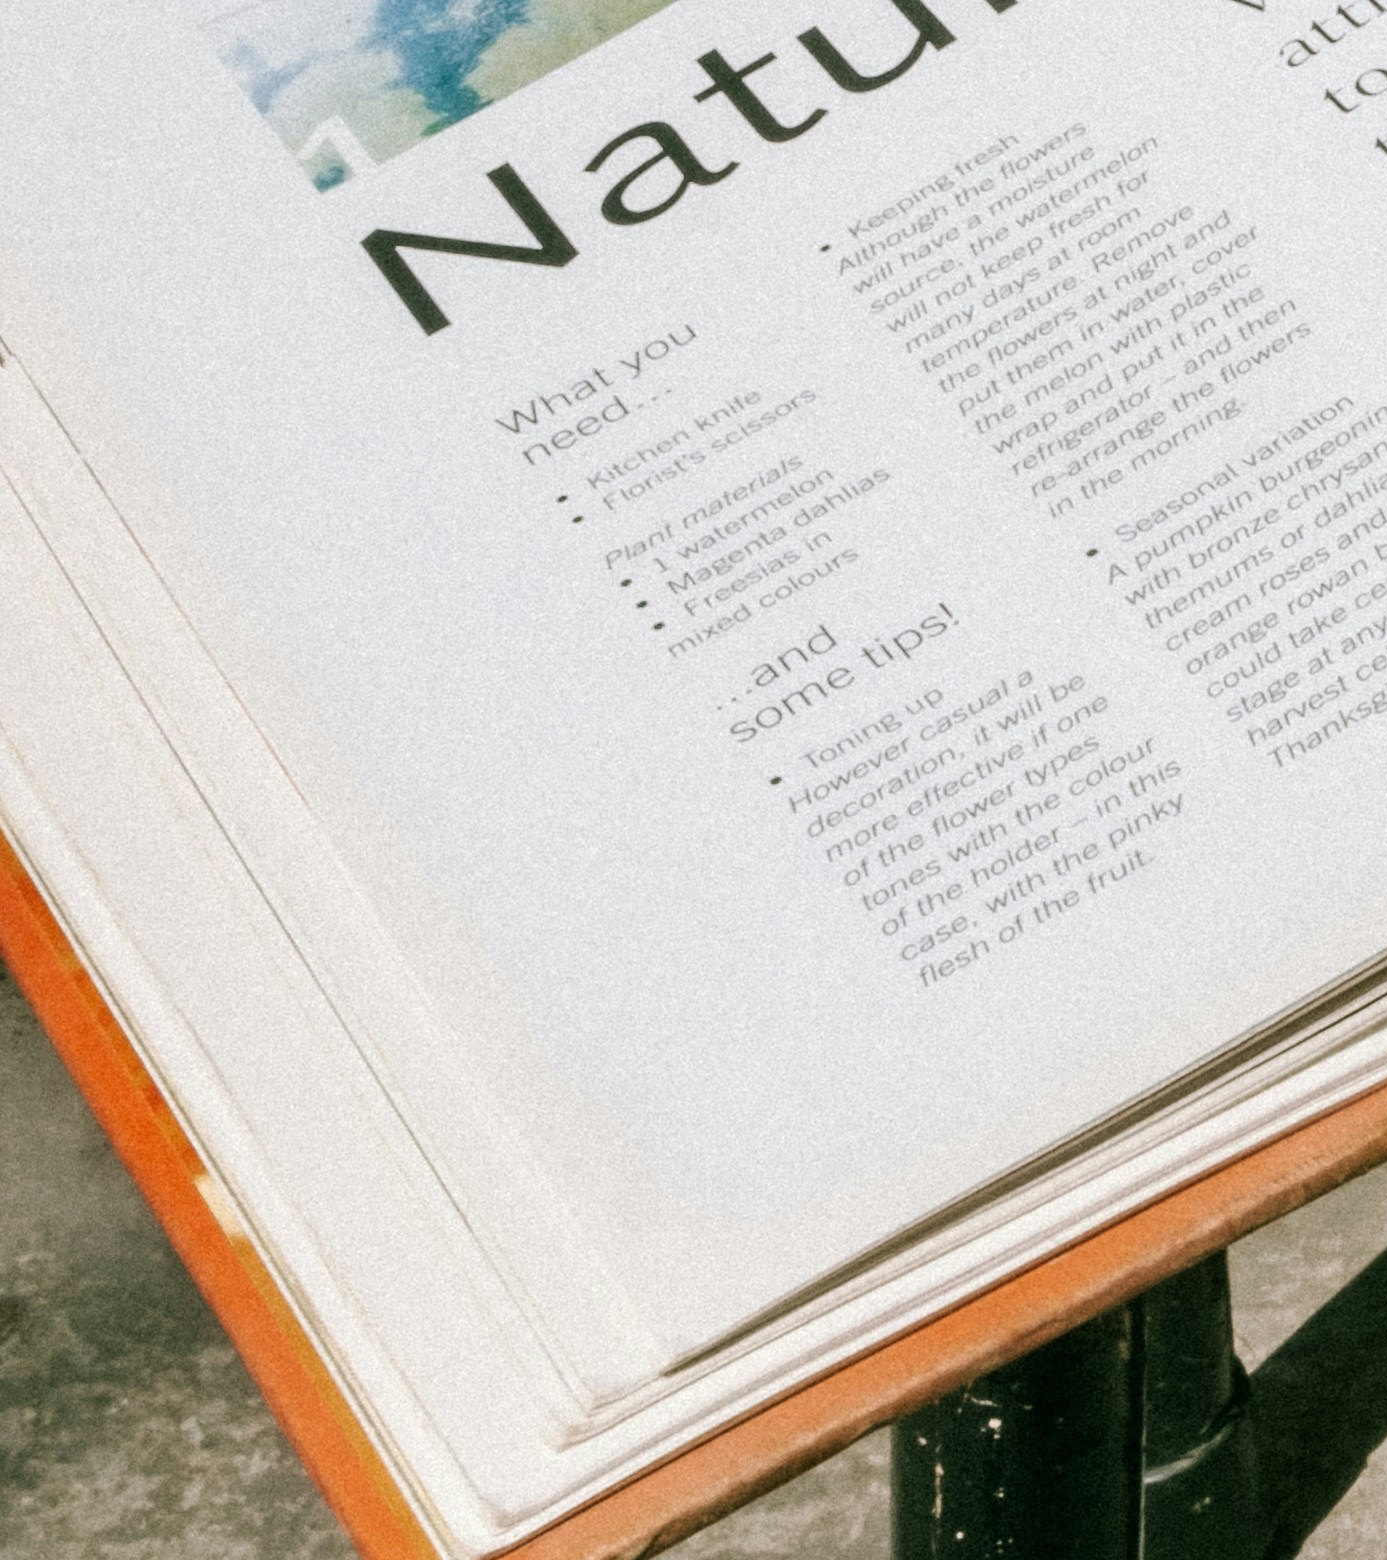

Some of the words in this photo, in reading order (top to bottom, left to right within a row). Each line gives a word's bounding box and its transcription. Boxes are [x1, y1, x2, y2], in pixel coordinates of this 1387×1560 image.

[837, 204, 949, 276] Although
[952, 177, 994, 208] the
[998, 121, 1087, 179] flowers
[845, 173, 955, 239] Keeping
[952, 133, 1020, 177] fresh
[851, 260, 894, 295] will
[898, 226, 959, 267] have
[966, 213, 982, 230] a
[987, 145, 1094, 216] moisture
[869, 258, 955, 314] source,
[967, 225, 1009, 257] the
[1014, 135, 1159, 229] watermelon
[493, 367, 612, 435] What
[618, 322, 698, 379] you
[585, 428, 691, 490] Kitchen
[692, 390, 762, 432] knife
[1029, 409, 1165, 498] re-arrange
[1170, 380, 1215, 413] the
[1218, 321, 1312, 384] flowers
[600, 449, 707, 512] Florist's
[709, 387, 818, 453] scissors
[1047, 495, 1075, 519] in
[1078, 467, 1124, 500] the
[1129, 397, 1246, 471] morning.
[1112, 462, 1239, 543] Seasonal
[1240, 395, 1355, 468] variation
[603, 521, 674, 571] Plant
[680, 454, 804, 530] materials
[652, 556, 669, 573] 1
[676, 468, 835, 560] watermelon
[664, 525, 788, 595] Magenta
[792, 467, 892, 528] dahlias
[681, 550, 801, 618] Freesias
[804, 531, 833, 553] in
[1106, 561, 1128, 586] A
[1133, 489, 1253, 572] pumpkin
[1123, 565, 1182, 607] with
[1186, 507, 1280, 570] bronze
[665, 602, 753, 659] mixed
[757, 547, 860, 609] colours
[1142, 545, 1274, 630] themums
[1279, 523, 1304, 549] or
[1163, 592, 1252, 652] cream
[1257, 546, 1331, 597] roses
[1336, 506, 1387, 551] and
[1184, 611, 1279, 676] orange
[1285, 557, 1369, 616] rowan
[729, 667, 855, 743] some
[861, 601, 959, 669] tips!
[1204, 640, 1283, 699] could
[1286, 605, 1346, 649] take
[1224, 670, 1300, 723] stage
[1307, 646, 1333, 675] at
[1340, 615, 1387, 656] any
[1245, 674, 1349, 747] harvest
[786, 737, 909, 814] However
[918, 677, 1010, 741] casual
[1016, 668, 1035, 689] a
[800, 711, 903, 769] Toning
[903, 687, 944, 716] up
[805, 746, 965, 839] decoration,
[973, 724, 991, 746] it
[995, 693, 1043, 732] will
[1047, 674, 1086, 704] be
[823, 813, 898, 863] more
[905, 742, 1023, 817] effective
[1031, 723, 1048, 748] if
[1055, 694, 1109, 734] one
[842, 856, 870, 888] of
[876, 832, 924, 868] the
[930, 782, 1013, 837] flower
[1022, 735, 1100, 787] types
[859, 858, 942, 912] tones
[946, 822, 1008, 863] with
[1013, 792, 1060, 827] the
[1067, 736, 1153, 797] colour
[879, 905, 908, 937] of
[915, 881, 963, 917] the
[969, 826, 1059, 887] holder
[1094, 793, 1123, 818] in
[1127, 759, 1182, 798] this
[899, 914, 978, 962] case,
[984, 871, 1046, 914] with
[1051, 841, 1100, 877] the
[1106, 792, 1184, 851] pinky
[917, 938, 991, 988] flesh
[997, 913, 1024, 944] of
[1031, 889, 1080, 925] the
[1085, 848, 1154, 895] fruit.
